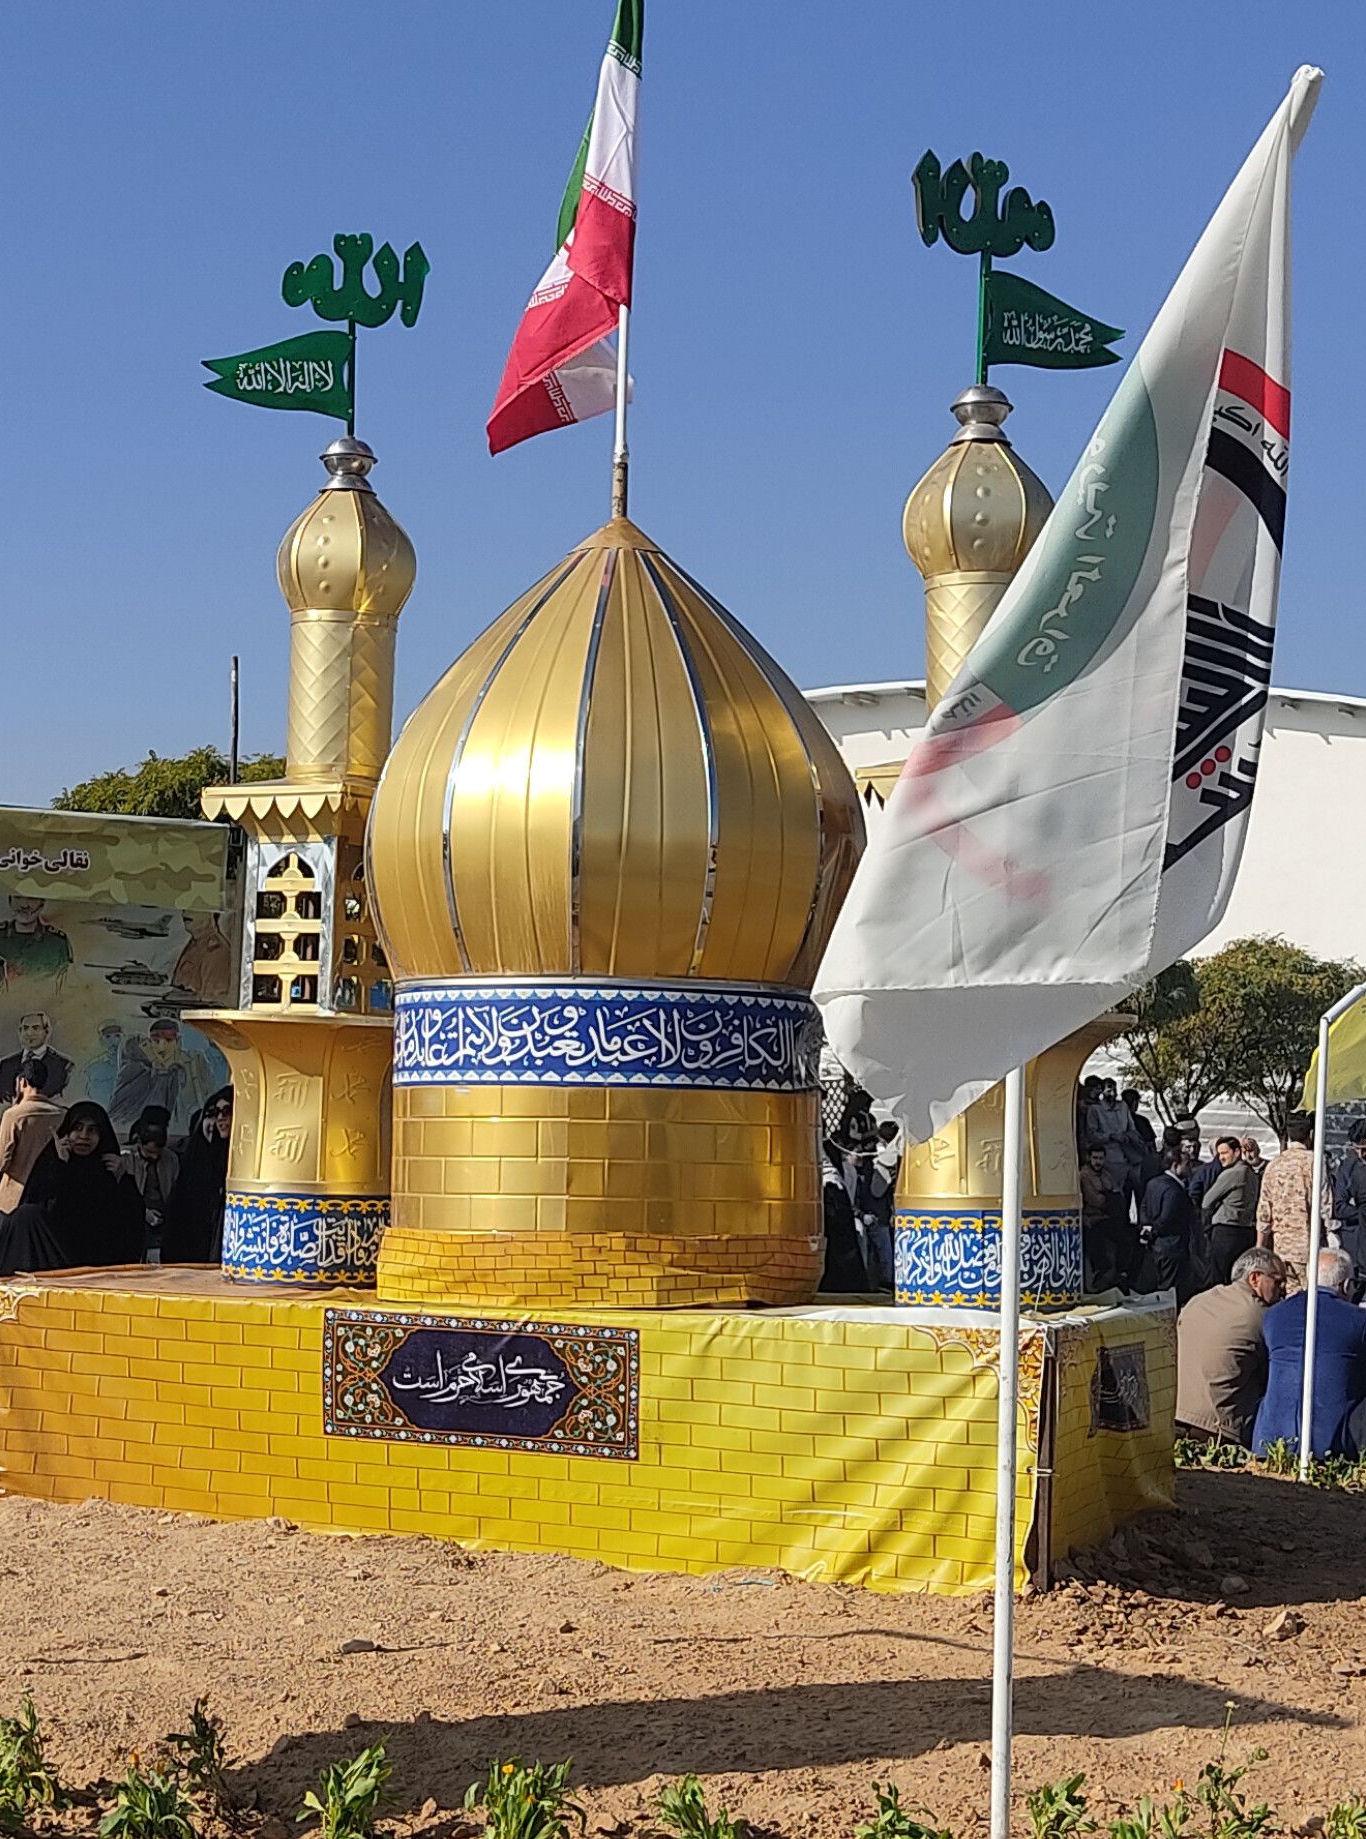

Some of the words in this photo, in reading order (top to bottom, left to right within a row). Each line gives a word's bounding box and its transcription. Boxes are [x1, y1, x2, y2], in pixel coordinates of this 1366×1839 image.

[282, 233, 430, 328] الله
[43, 850, 90, 872] نقالی
[392, 1349, 444, 1390] است
